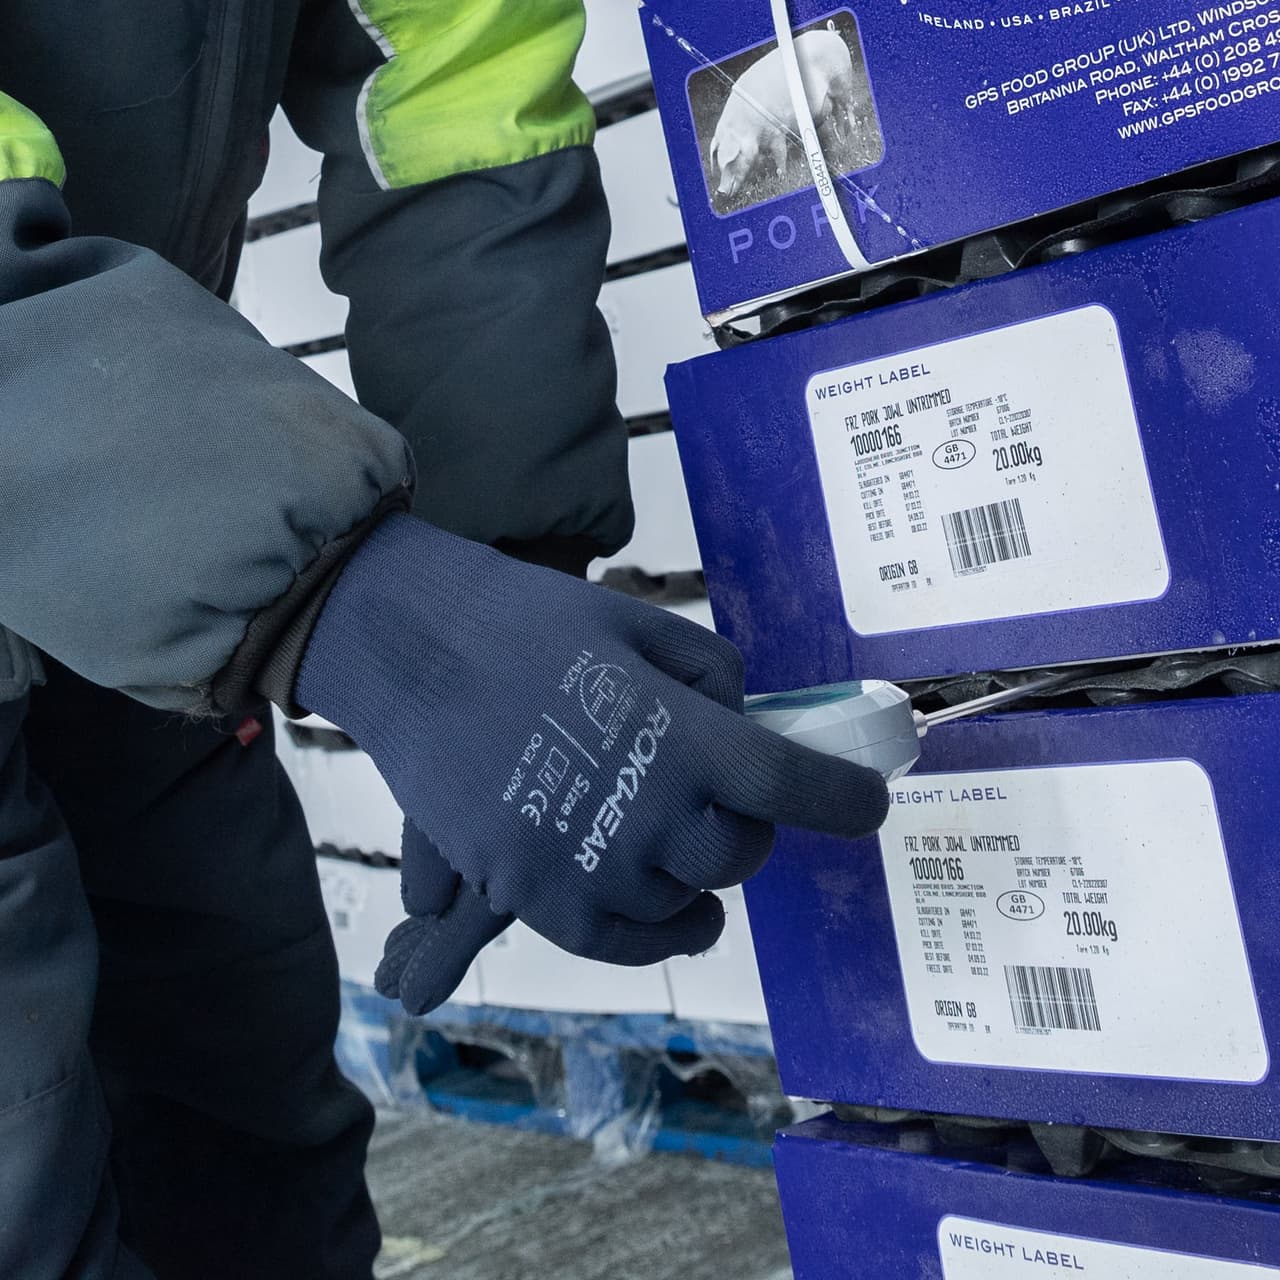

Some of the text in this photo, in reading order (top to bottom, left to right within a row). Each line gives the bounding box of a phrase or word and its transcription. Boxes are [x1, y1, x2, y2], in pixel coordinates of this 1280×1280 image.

[918, 12, 984, 29] IRELAND
[1000, 14, 1033, 27] USA
[965, 87, 998, 108] GPS
[1001, 69, 1048, 96] FOOD
[1051, 44, 1117, 77] GROUP
[1118, 29, 1155, 56] (UK)
[1158, 19, 1195, 40] LTD,
[1007, 78, 1087, 114] BRITANNIA
[1089, 60, 1140, 85] ROAD,
[1141, 28, 1224, 66] WALTHAM
[1097, 75, 1158, 104] PHONE:
[1161, 60, 1192, 81] +44
[1195, 50, 1220, 72] (0)
[1223, 37, 1261, 61] 208
[1124, 96, 1158, 116] FAX:
[1161, 82, 1192, 103] +44
[1194, 72, 1219, 94] (0)
[1221, 58, 1266, 83] 1992
[807, 151, 832, 197] GB4471
[815, 363, 930, 400] WEIGHT LABEL
[850, 423, 902, 456] 10000166
[992, 440, 1042, 471] 20.00kg
[555, 772, 589, 832] Size 9
[574, 698, 671, 872] ROKWEAR
[949, 787, 1007, 801] LABEL
[908, 856, 964, 880] 10000166
[1063, 910, 1118, 941] 20.00kg
[949, 1233, 1084, 1270] WEIGHT LABEL
